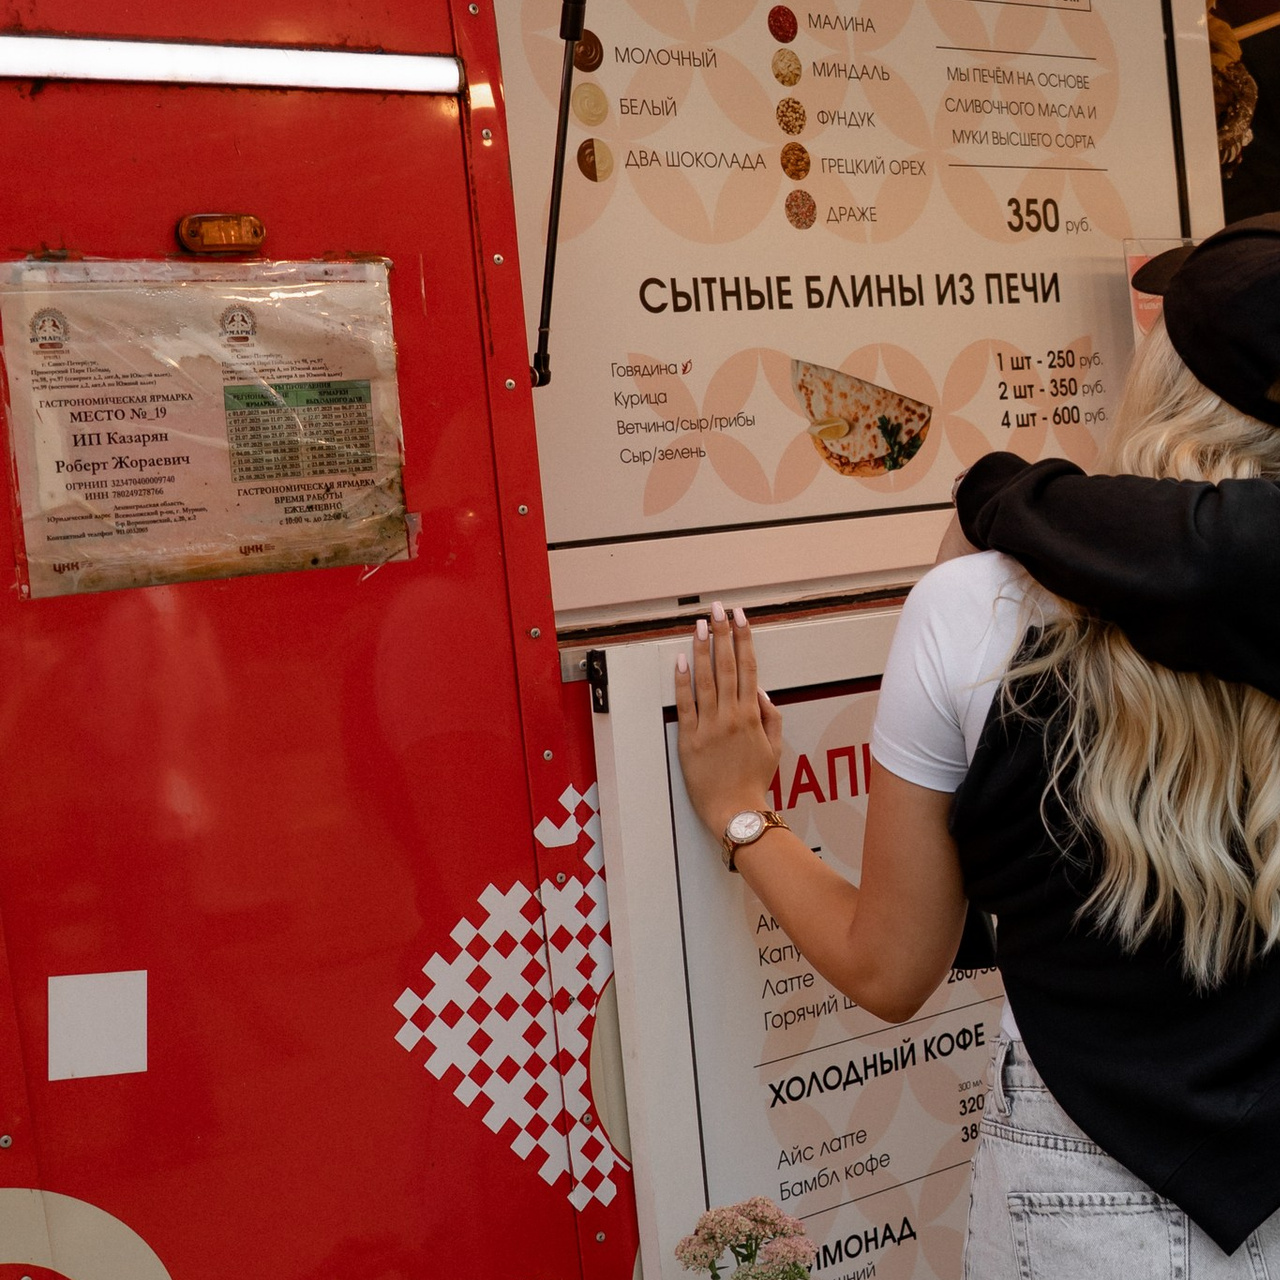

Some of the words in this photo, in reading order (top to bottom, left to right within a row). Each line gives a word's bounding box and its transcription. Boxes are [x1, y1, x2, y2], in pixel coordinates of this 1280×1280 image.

[808, 13, 876, 33] МАЛИНА
[615, 46, 718, 68] МОЛОЧНЫЙ
[812, 62, 890, 81] МИНДАЛЬ
[947, 66, 970, 82] МЫ
[973, 67, 1014, 85] ПЕЧЁМ
[1017, 72, 1035, 86] НА
[1038, 72, 1090, 90] ОСНОВЕ
[619, 96, 678, 117] БЕЛЫЙ
[945, 97, 1035, 117] СЛИВОЧНОГО
[1038, 103, 1085, 119] МАСЛА
[1088, 106, 1097, 119] И
[817, 110, 876, 128] ФУНДУК
[952, 129, 989, 145] МУКИ
[992, 131, 1052, 148] ВЫСШЕГО
[1055, 133, 1096, 149] СОРТА
[625, 150, 662, 169] ДВА
[666, 151, 766, 171] ШОКОЛАДА
[821, 156, 885, 176] ГРЕЦКИЙ
[889, 160, 927, 176] ОРЕХ
[826, 207, 877, 224] ДРАЖЕ
[1006, 197, 1060, 233] 350
[1065, 216, 1092, 235] руб.
[639, 275, 793, 314] СЫТНЫЕ
[805, 273, 925, 310] БЛИНЫ
[936, 273, 975, 306] ИЗ
[985, 272, 1061, 305] ПЕЧИ
[611, 362, 678, 378] Говядина
[997, 353, 1004, 371] 1
[1010, 355, 1032, 371] шт
[1047, 350, 1075, 369] 250
[1079, 352, 1104, 371] руб.
[613, 391, 668, 409] Курица
[998, 382, 1009, 401] 2
[1012, 383, 1035, 400] шт
[1049, 378, 1078, 397] 350
[1082, 380, 1106, 398] руб.
[39, 395, 148, 408] ГАСТРОНОМИЧЕСКАЯ
[149, 393, 194, 403] ЯРМАРКА
[69, 409, 126, 423] МЕСТО
[617, 412, 756, 435] Ветчина/сыр/грибы
[1000, 410, 1012, 429] 4
[1015, 411, 1038, 428] шт
[1052, 406, 1081, 425] 600
[1084, 407, 1109, 425] руб.
[71, 432, 101, 447] ИП
[106, 431, 169, 447] Казарян
[55, 459, 109, 476] Роберт
[111, 455, 191, 472] Жораевич
[620, 446, 707, 466] Сыр/зелень
[65, 479, 108, 491] ОГРНИП
[237, 481, 335, 497] ГАСТРОНОМИЧЕСКАЯ
[85, 491, 109, 501] ИНН
[274, 494, 305, 505] ВРЕМЯ
[306, 491, 344, 502] РАБОТЫ
[284, 501, 343, 515] ЕЖЕДНЕВНО
[761, 972, 815, 1000] Латте
[763, 995, 838, 1031] Горячий
[768, 1037, 917, 1109] ХОЛОДНЫЙ
[923, 1022, 985, 1062] КОФЕ
[959, 1093, 985, 1116] 320
[961, 1122, 980, 1143] 38
[777, 1145, 815, 1170] Айс
[819, 1129, 868, 1157] латте
[779, 1167, 841, 1201] Бамбл
[844, 1153, 891, 1181] кофе
[806, 1216, 917, 1273] МОНАД
